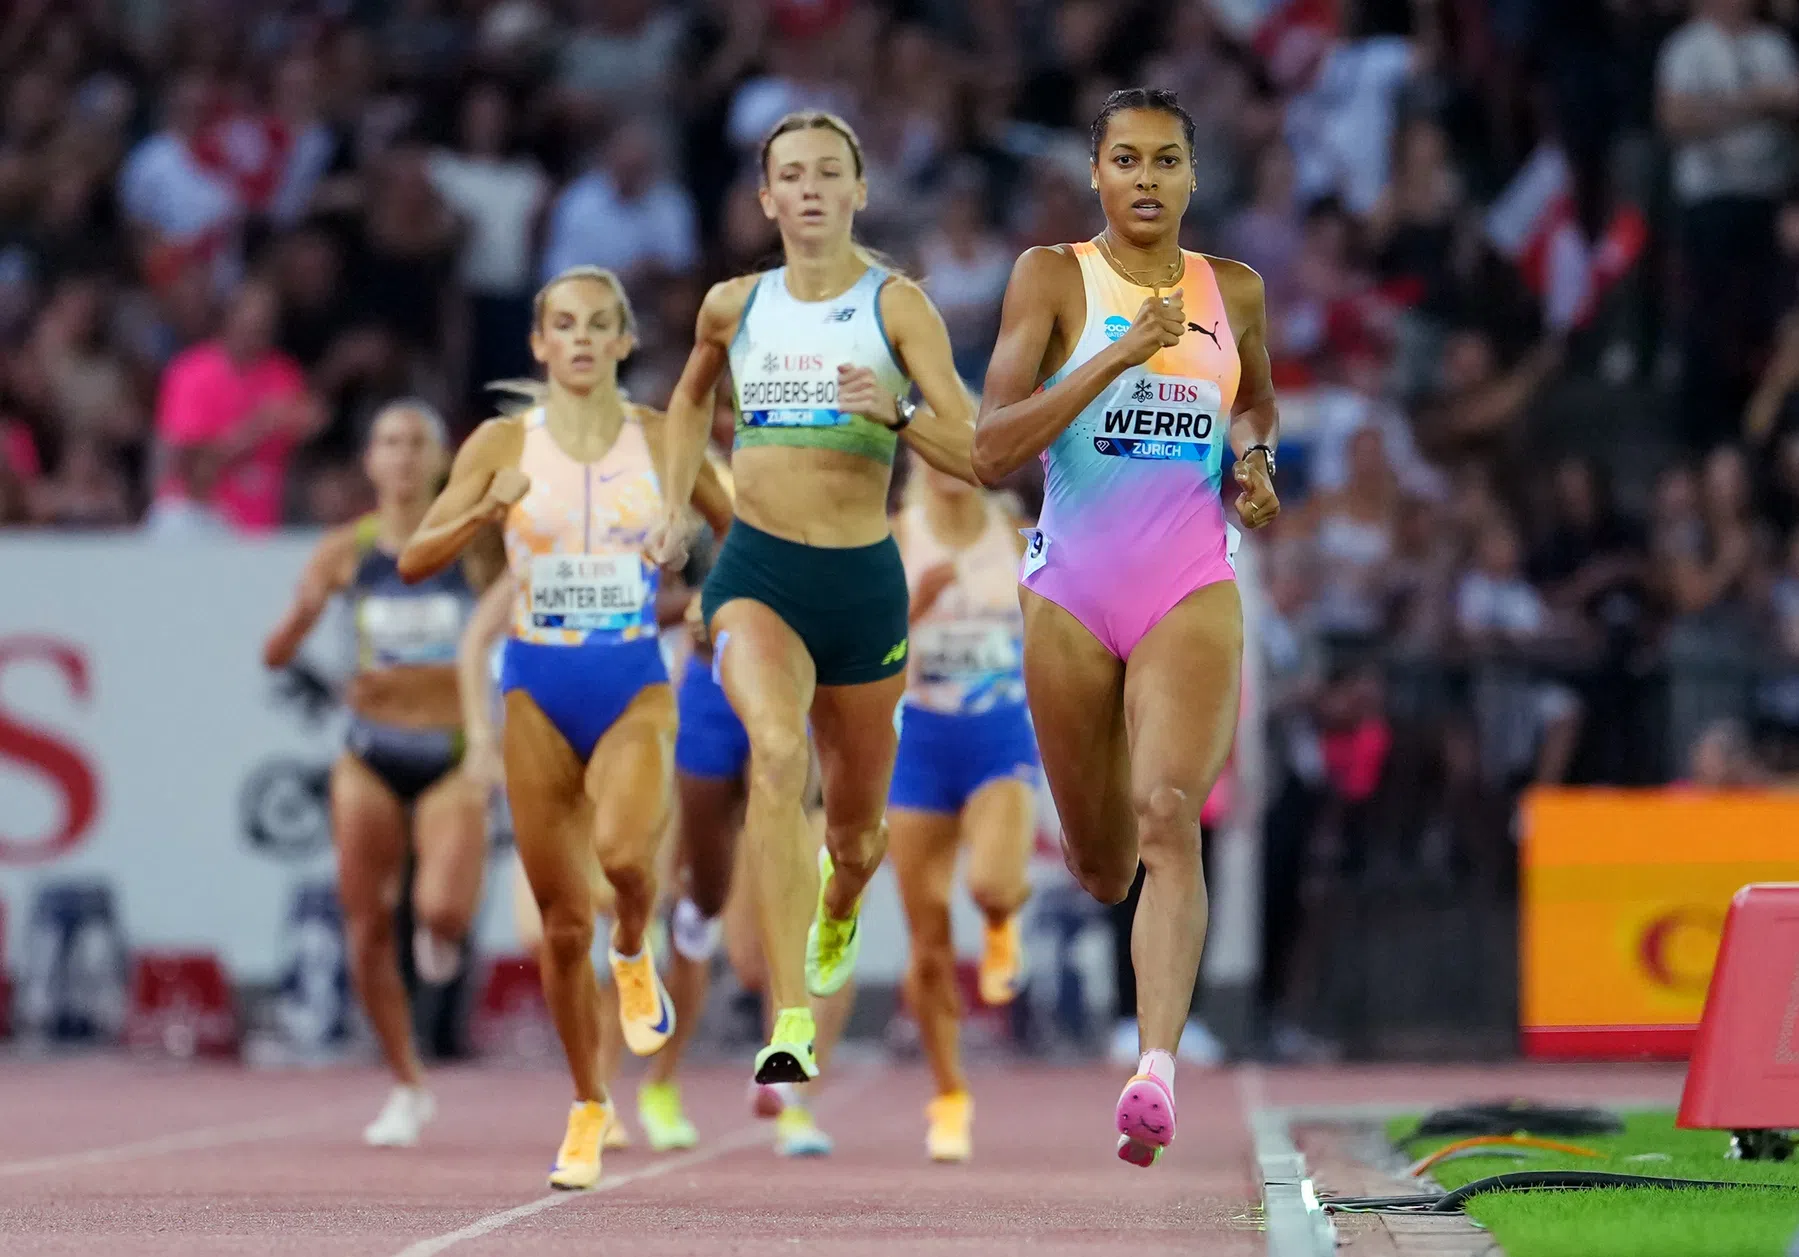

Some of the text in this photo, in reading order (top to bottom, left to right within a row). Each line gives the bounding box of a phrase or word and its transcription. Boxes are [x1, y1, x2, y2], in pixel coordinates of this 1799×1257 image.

[1104, 323, 1131, 333] FOCU
[784, 355, 823, 370] UBS
[743, 381, 838, 404] BROEDERS-BO
[1158, 382, 1199, 403] UBS
[1104, 409, 1212, 439] WERRO
[1132, 442, 1182, 457] ZURICH
[1031, 531, 1043, 558] 9
[534, 586, 636, 608] HUNTER BELL
